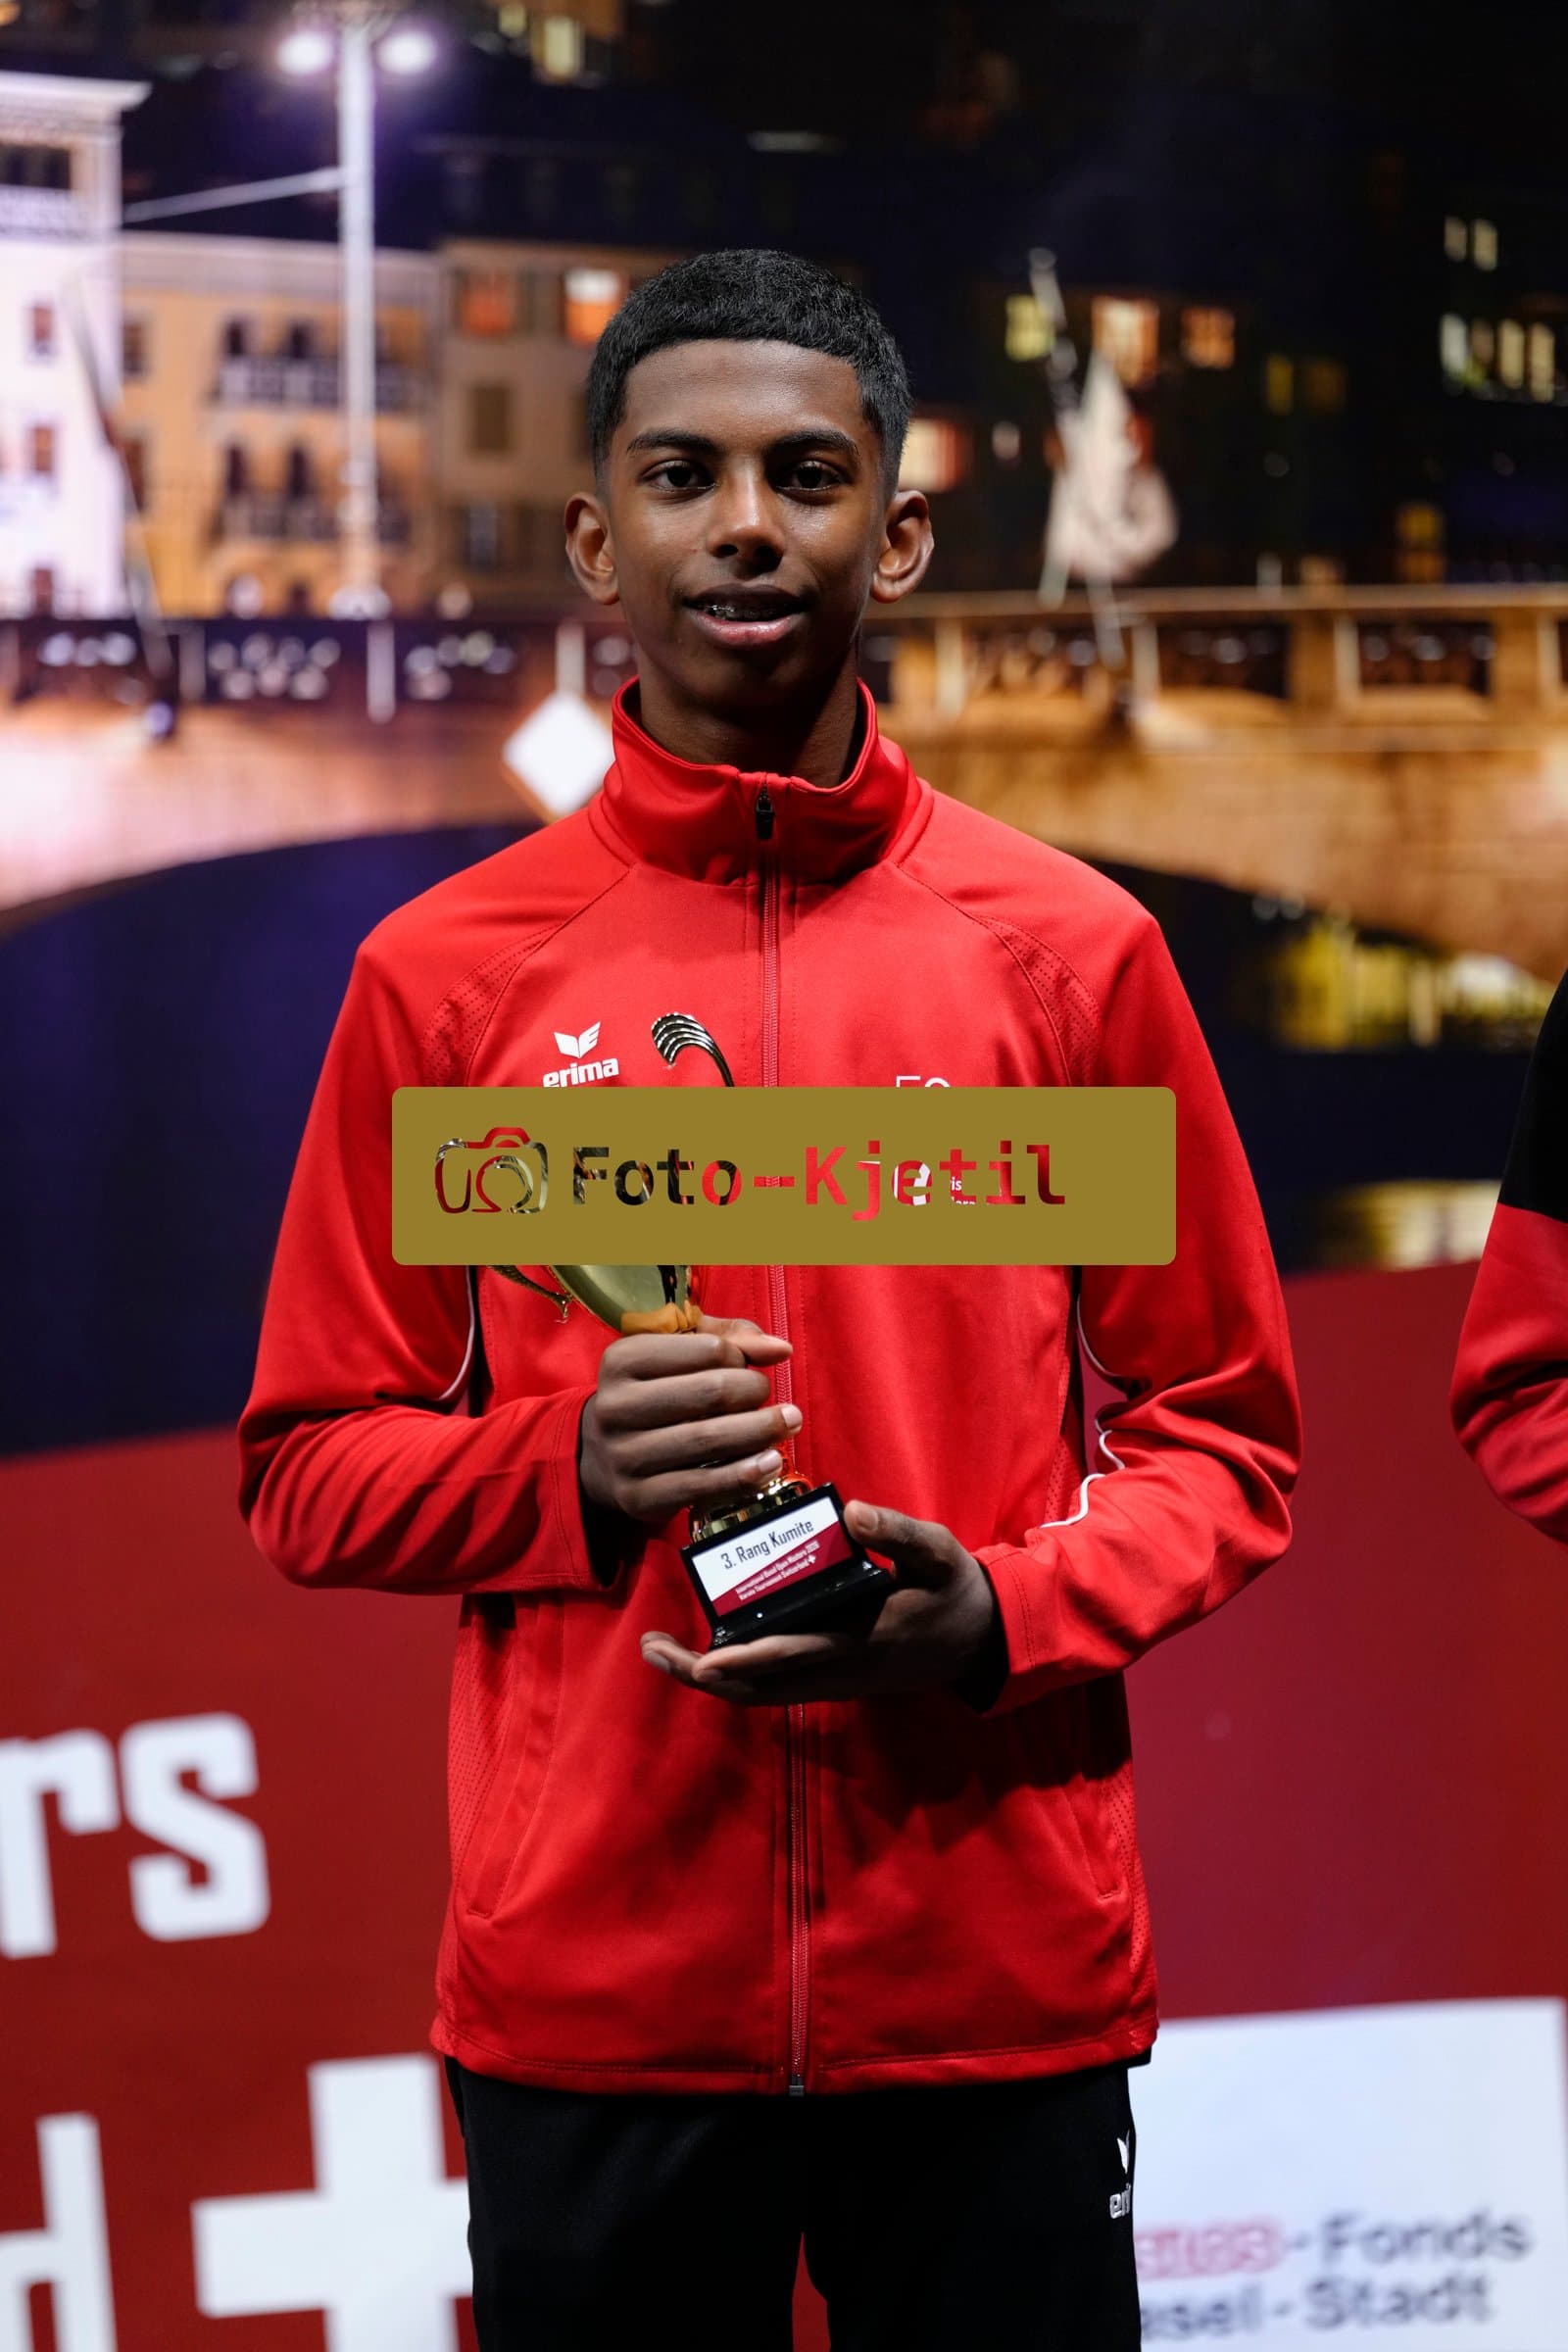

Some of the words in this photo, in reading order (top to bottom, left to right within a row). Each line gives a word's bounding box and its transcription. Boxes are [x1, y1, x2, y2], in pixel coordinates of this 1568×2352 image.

[543, 1057, 619, 1087] erima
[720, 1552, 737, 1569] 3.
[735, 1541, 770, 1563] Rang
[768, 1520, 814, 1548] Kumite
